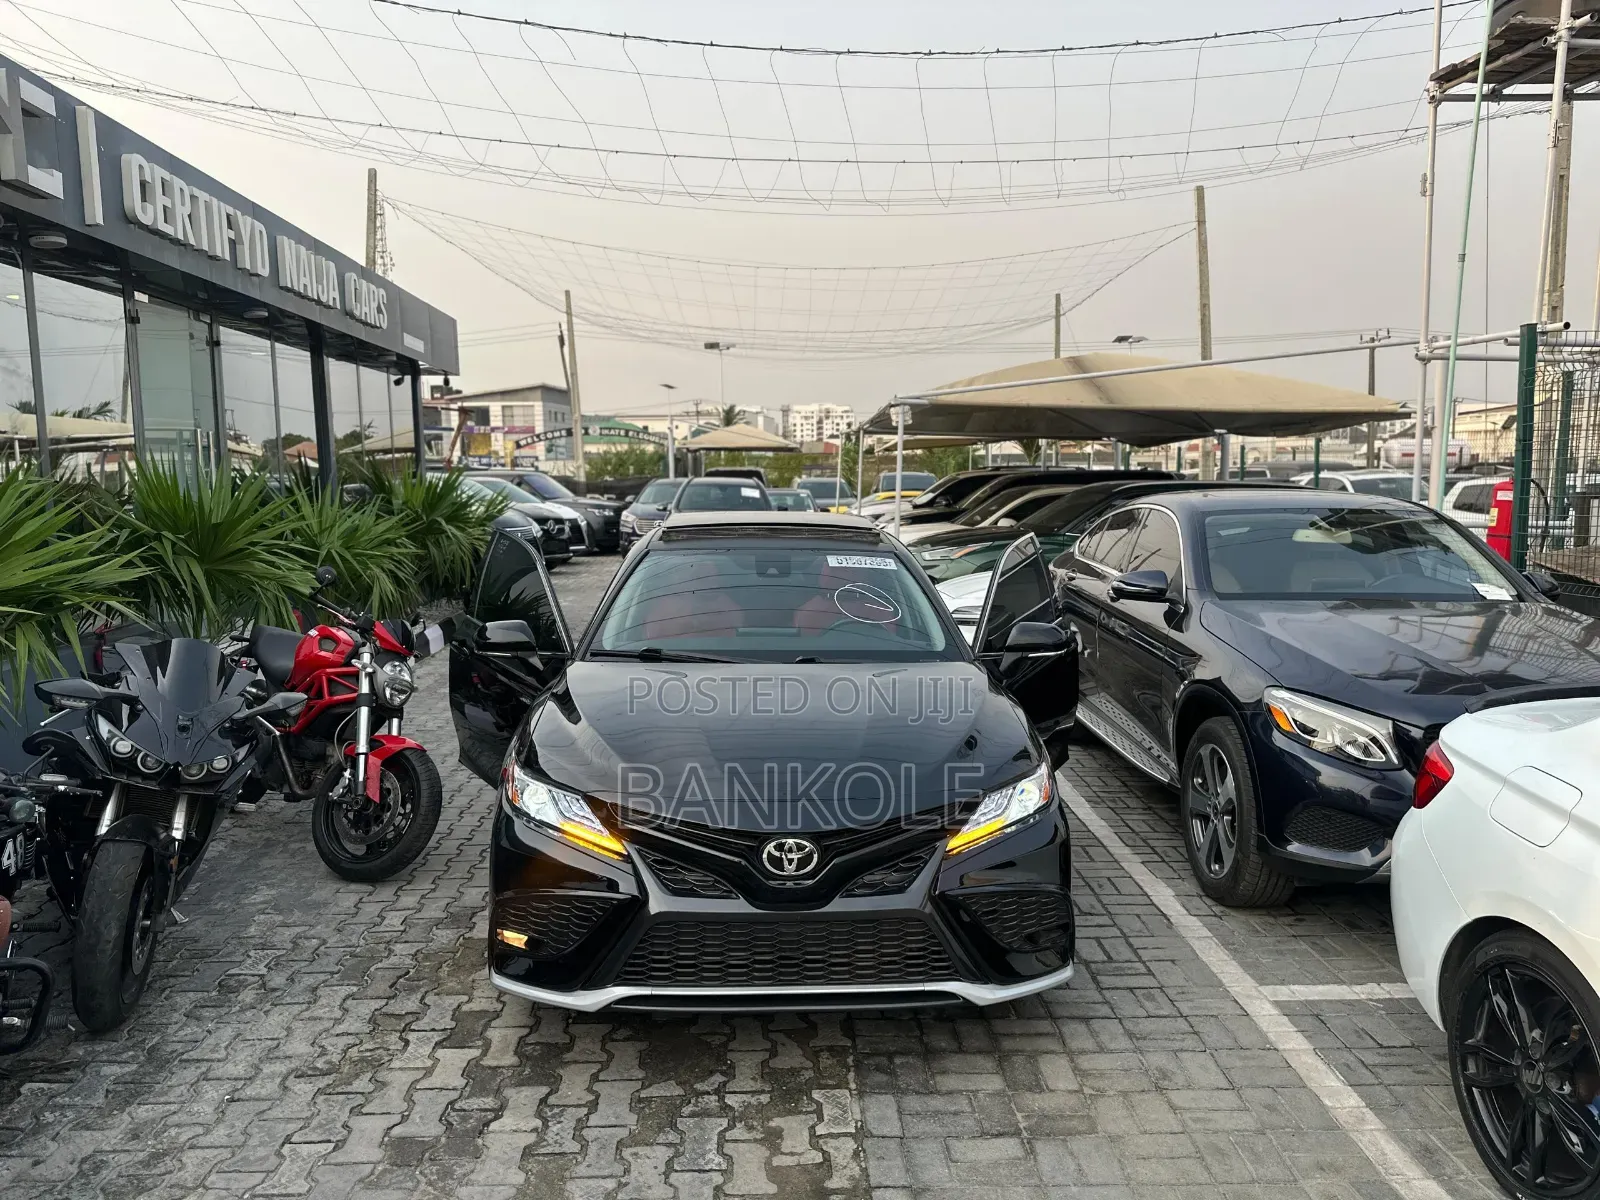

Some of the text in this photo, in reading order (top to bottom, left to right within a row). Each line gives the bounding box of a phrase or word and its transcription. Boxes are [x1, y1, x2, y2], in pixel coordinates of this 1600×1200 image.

[121, 153, 388, 330] CERTIFYD NAIJA CARS
[518, 429, 567, 447] WELCOME
[601, 428, 626, 437] IKATE
